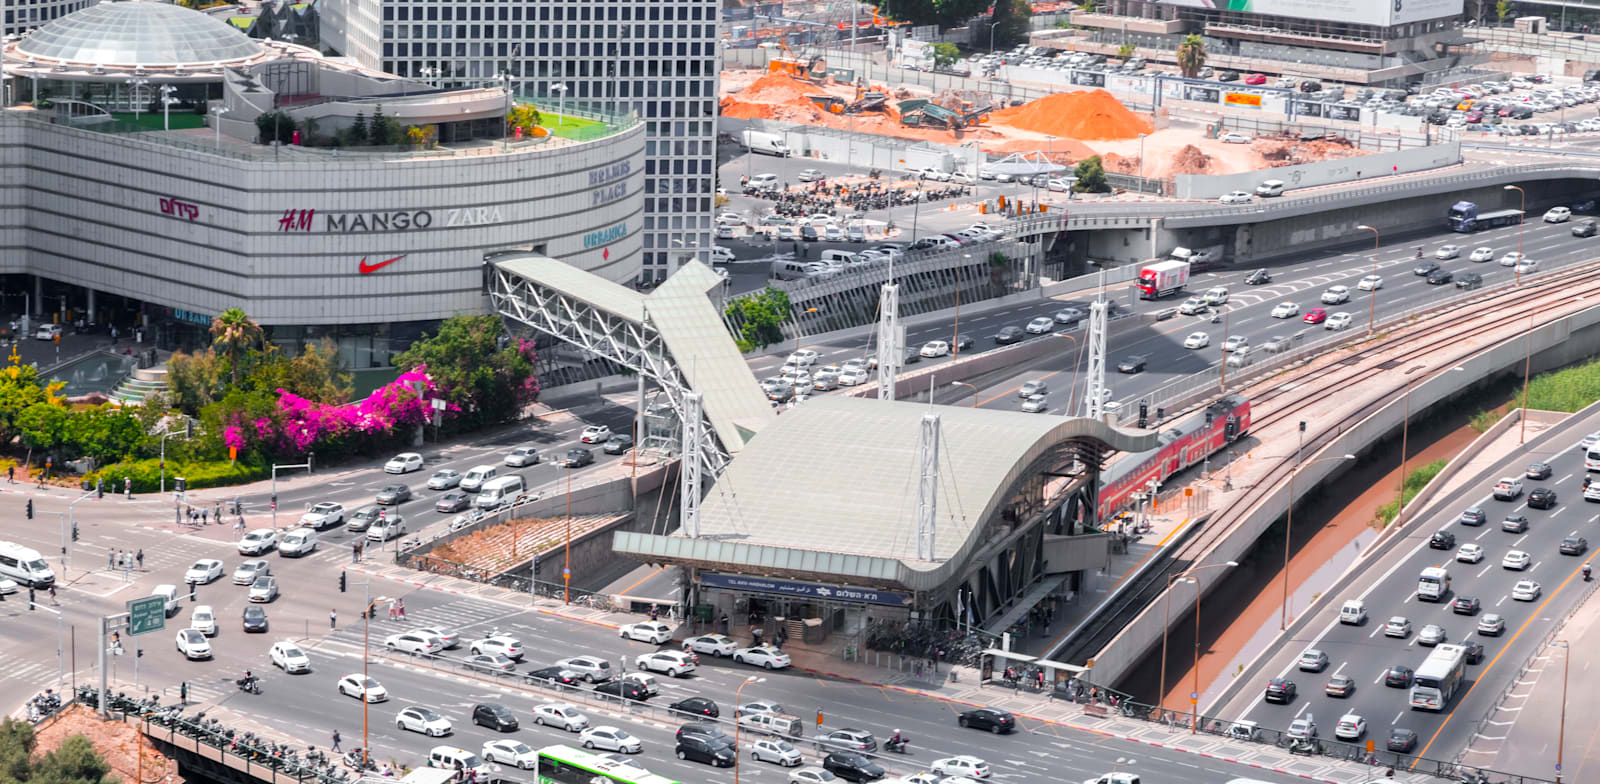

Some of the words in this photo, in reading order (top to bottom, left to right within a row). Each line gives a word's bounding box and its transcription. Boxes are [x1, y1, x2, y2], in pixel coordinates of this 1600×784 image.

[278, 208, 315, 232] H&M
[327, 211, 432, 232] MANGO
[447, 206, 502, 228] ZARA
[584, 223, 627, 249] URBANICA
[175, 308, 210, 326] URBANI
